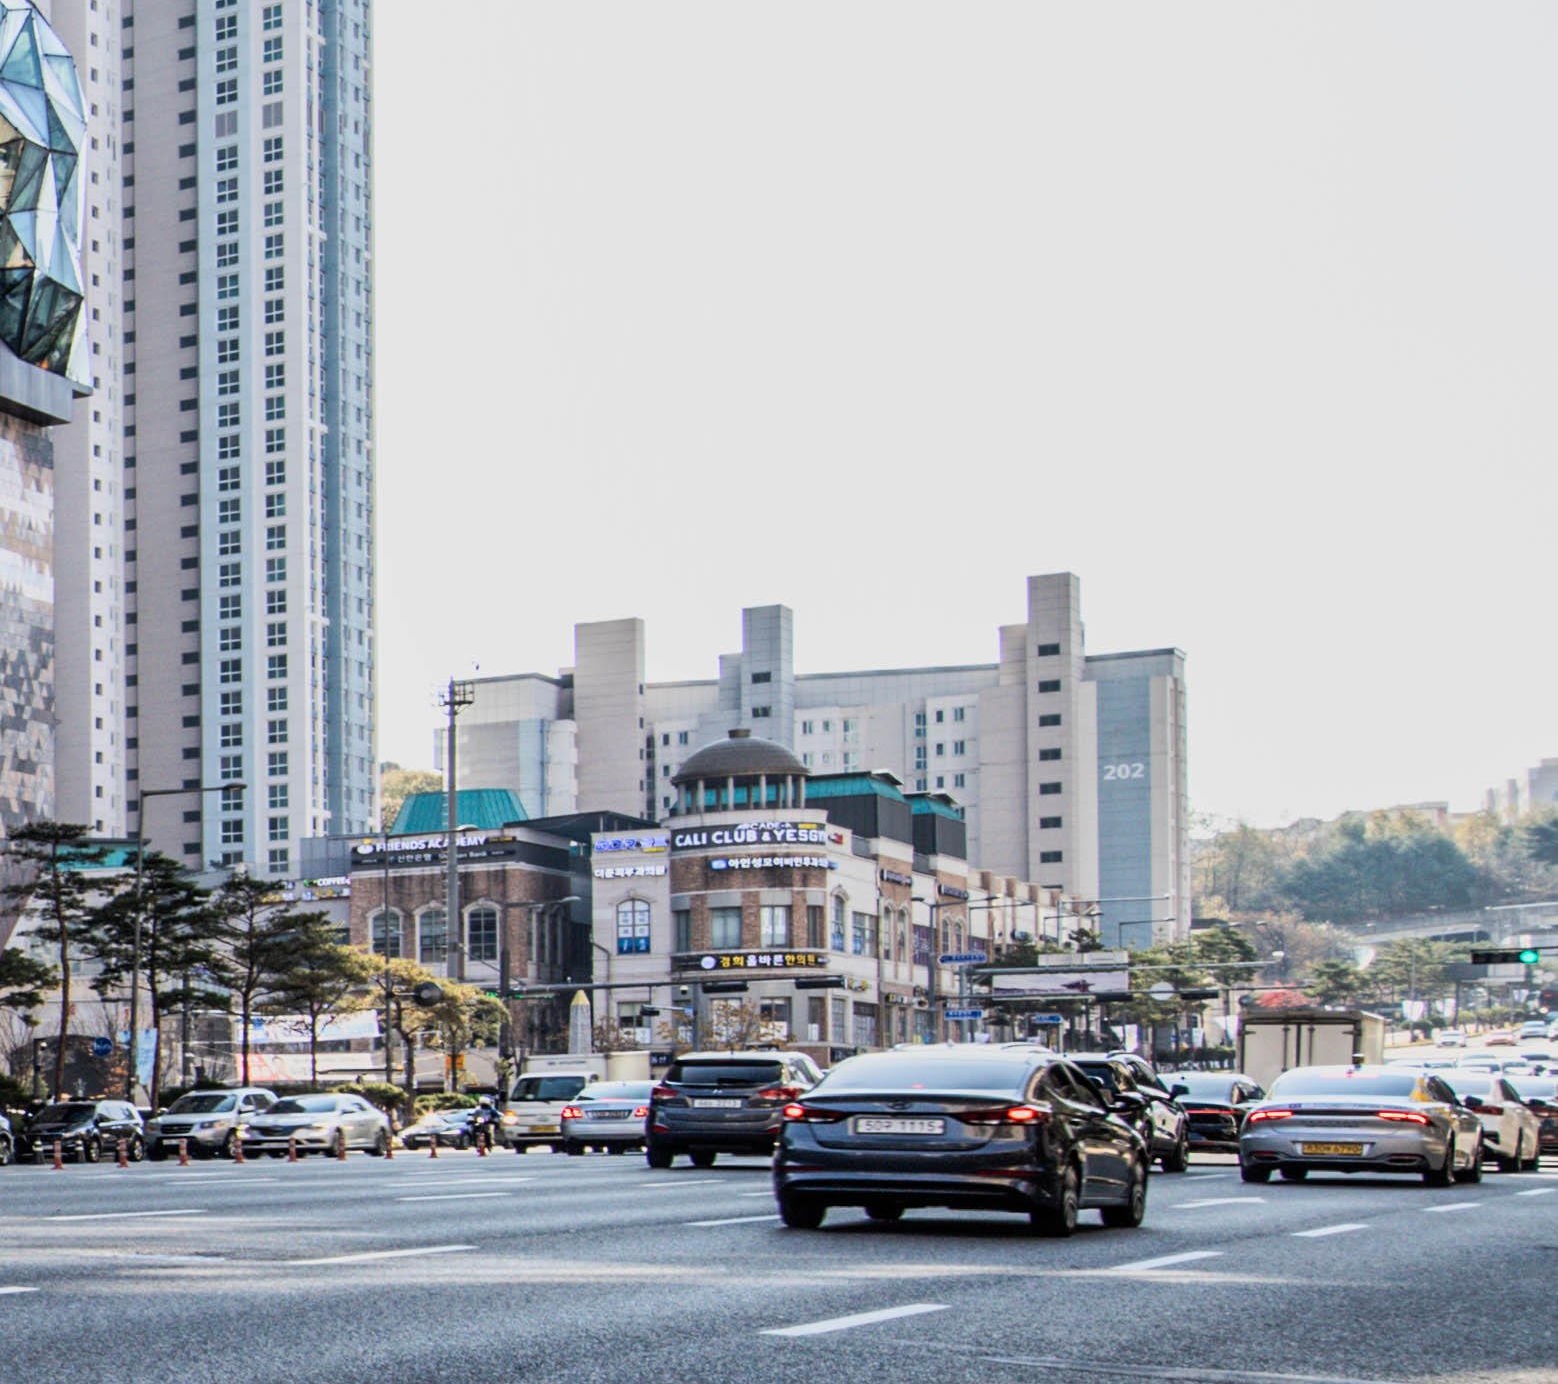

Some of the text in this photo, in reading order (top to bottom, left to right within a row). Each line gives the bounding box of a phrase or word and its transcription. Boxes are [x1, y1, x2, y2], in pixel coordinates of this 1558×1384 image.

[1103, 763, 1145, 781] 202
[675, 831, 707, 848] CALI
[712, 830, 757, 845] CLUB
